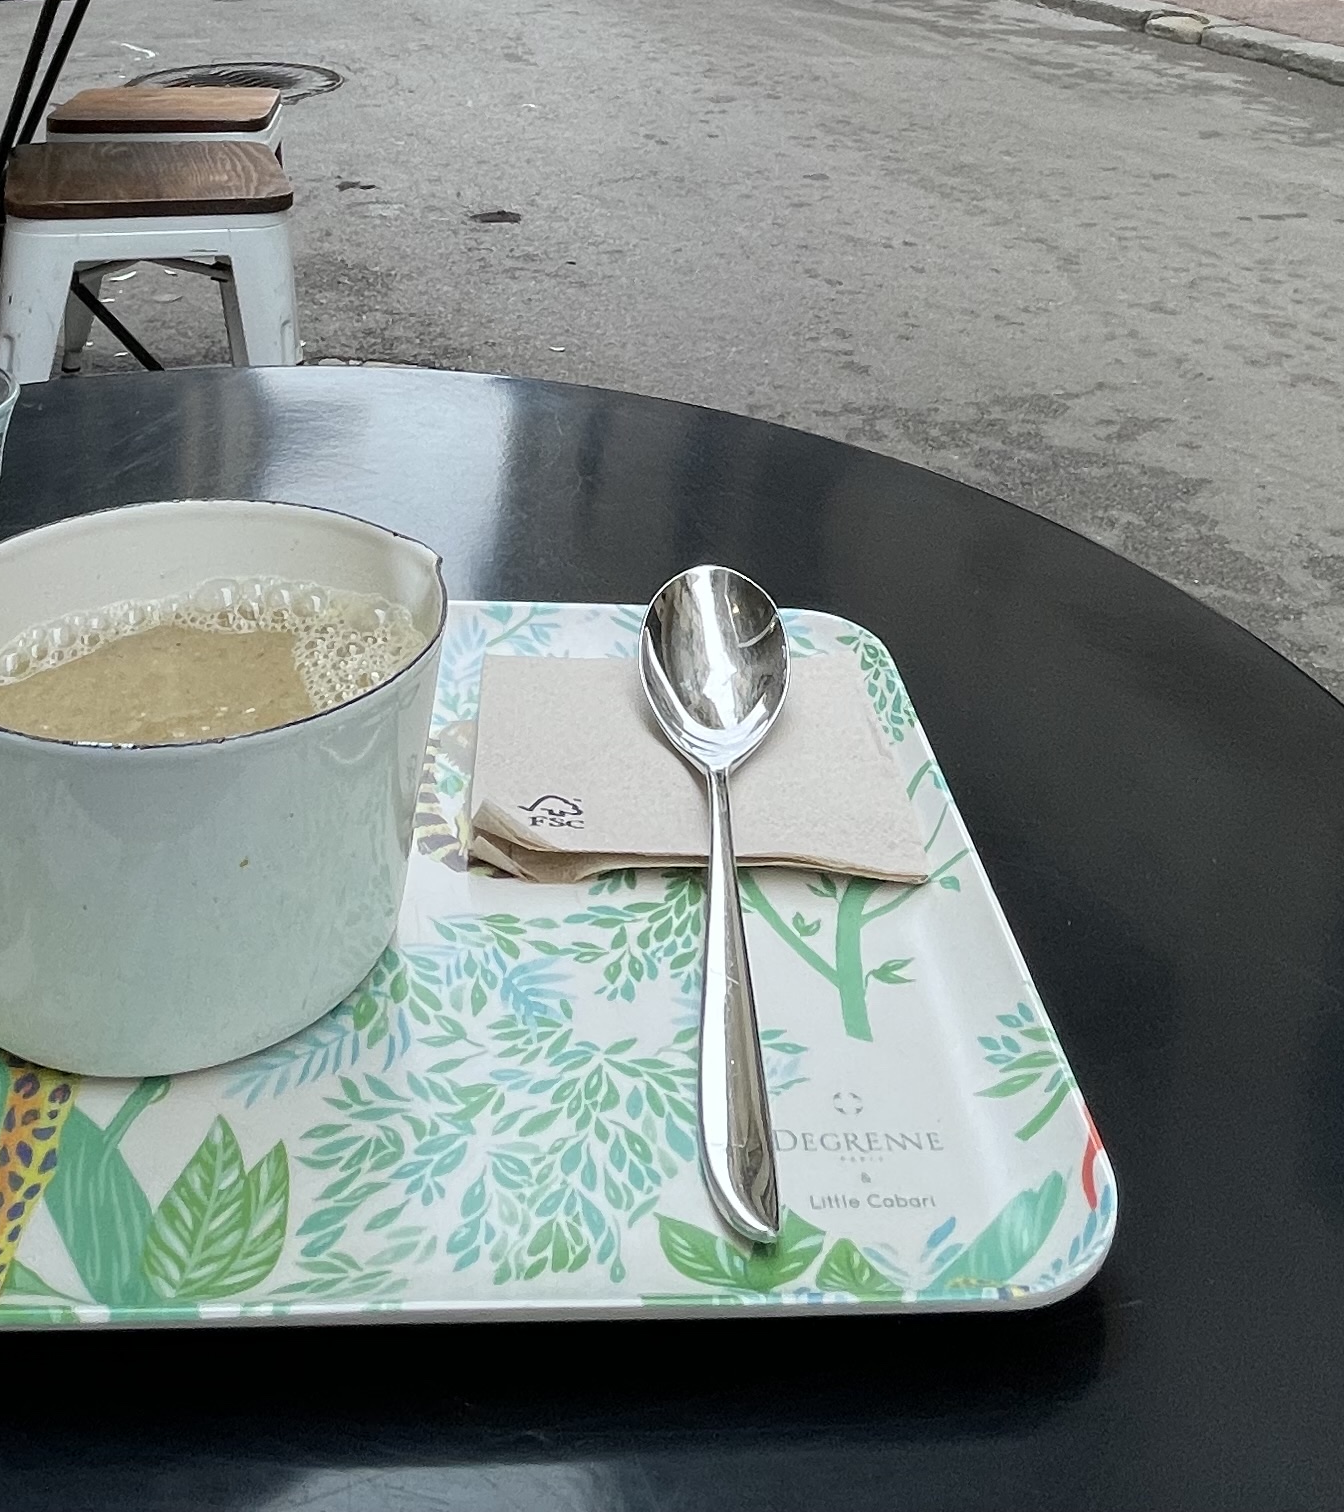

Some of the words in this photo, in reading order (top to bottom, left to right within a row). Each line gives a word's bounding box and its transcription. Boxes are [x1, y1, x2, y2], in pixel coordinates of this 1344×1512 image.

[529, 816, 585, 829] FSC
[772, 1129, 944, 1153] DEGRENNE
[809, 1194, 860, 1210] Little
